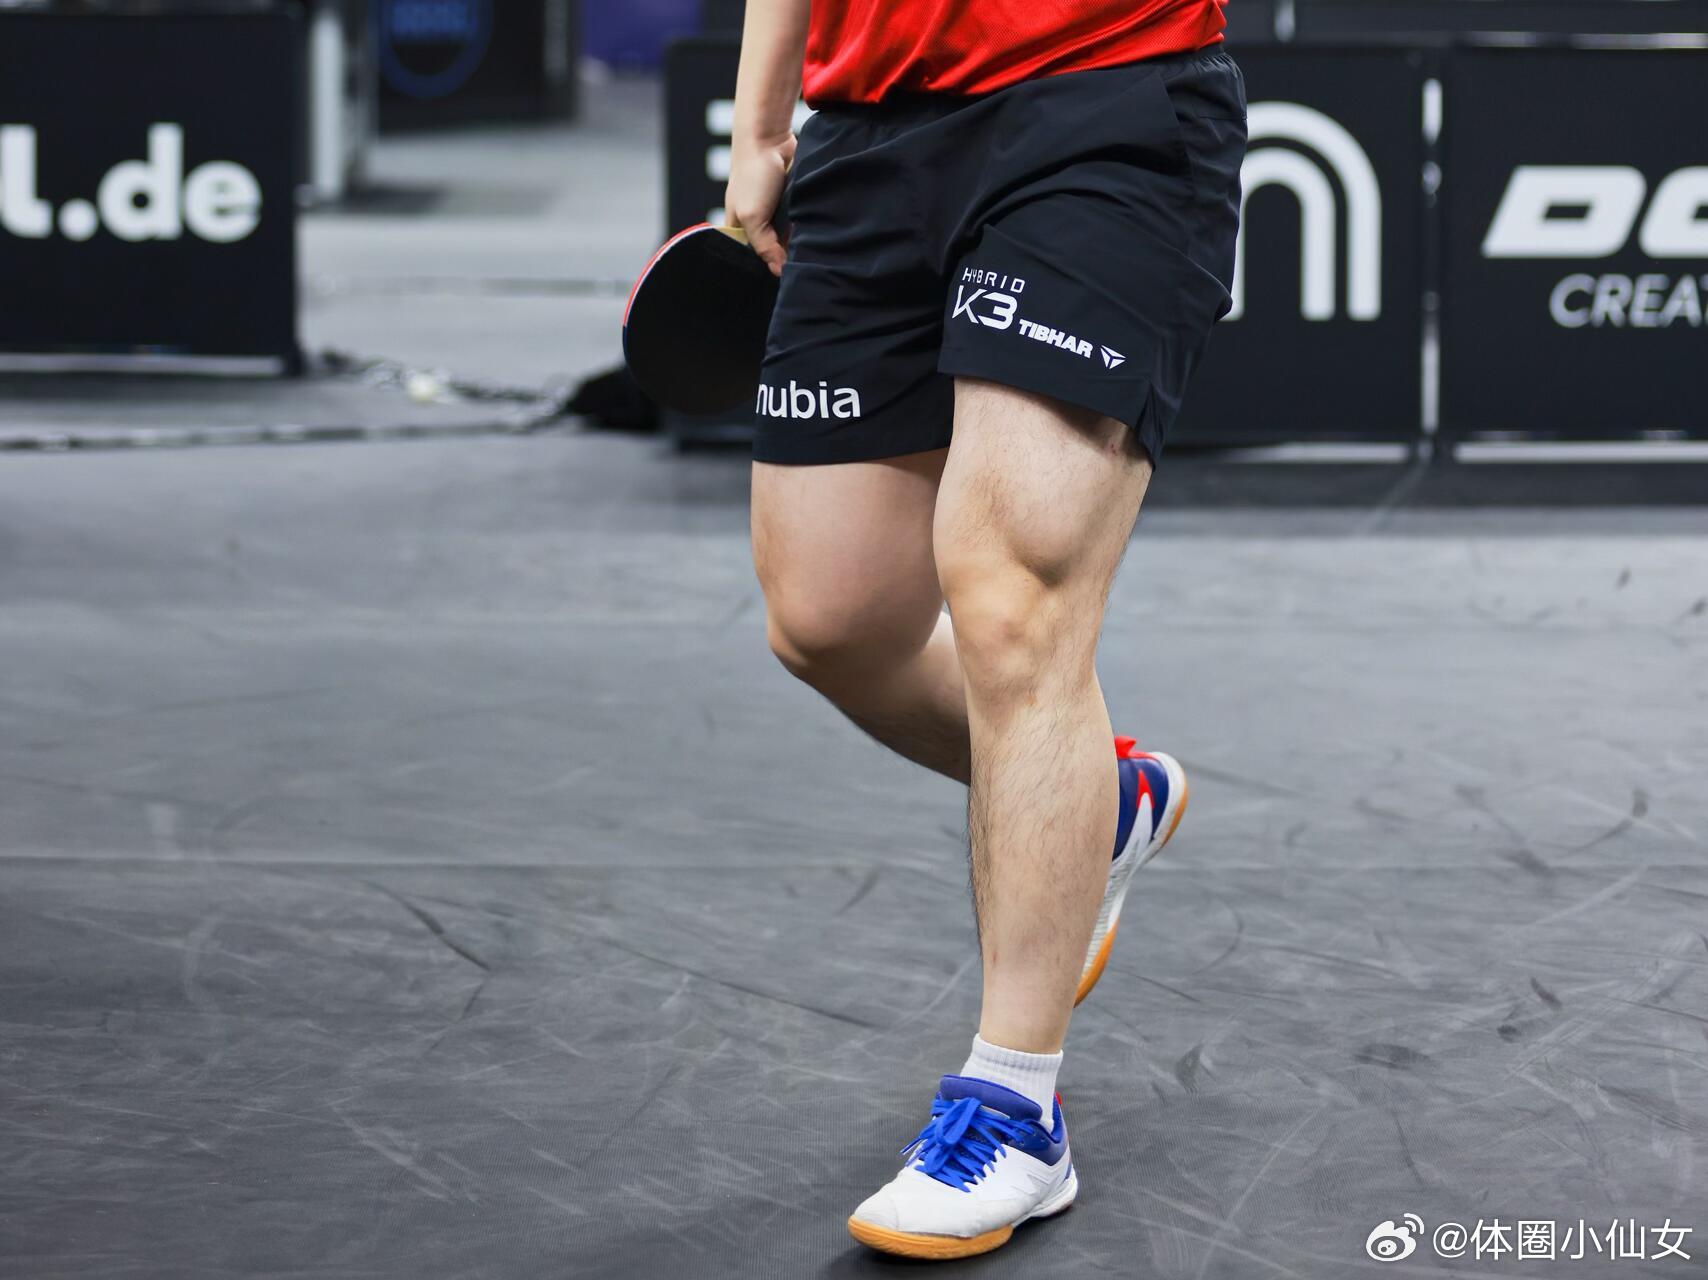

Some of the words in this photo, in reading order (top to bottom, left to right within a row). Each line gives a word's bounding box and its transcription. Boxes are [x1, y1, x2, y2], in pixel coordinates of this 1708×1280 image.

[962, 267, 1026, 294] HYBRID
[1549, 273, 1708, 328] CREA
[952, 284, 1018, 330] K3
[1018, 318, 1094, 359] TIBHAR
[755, 380, 861, 419] nubia
